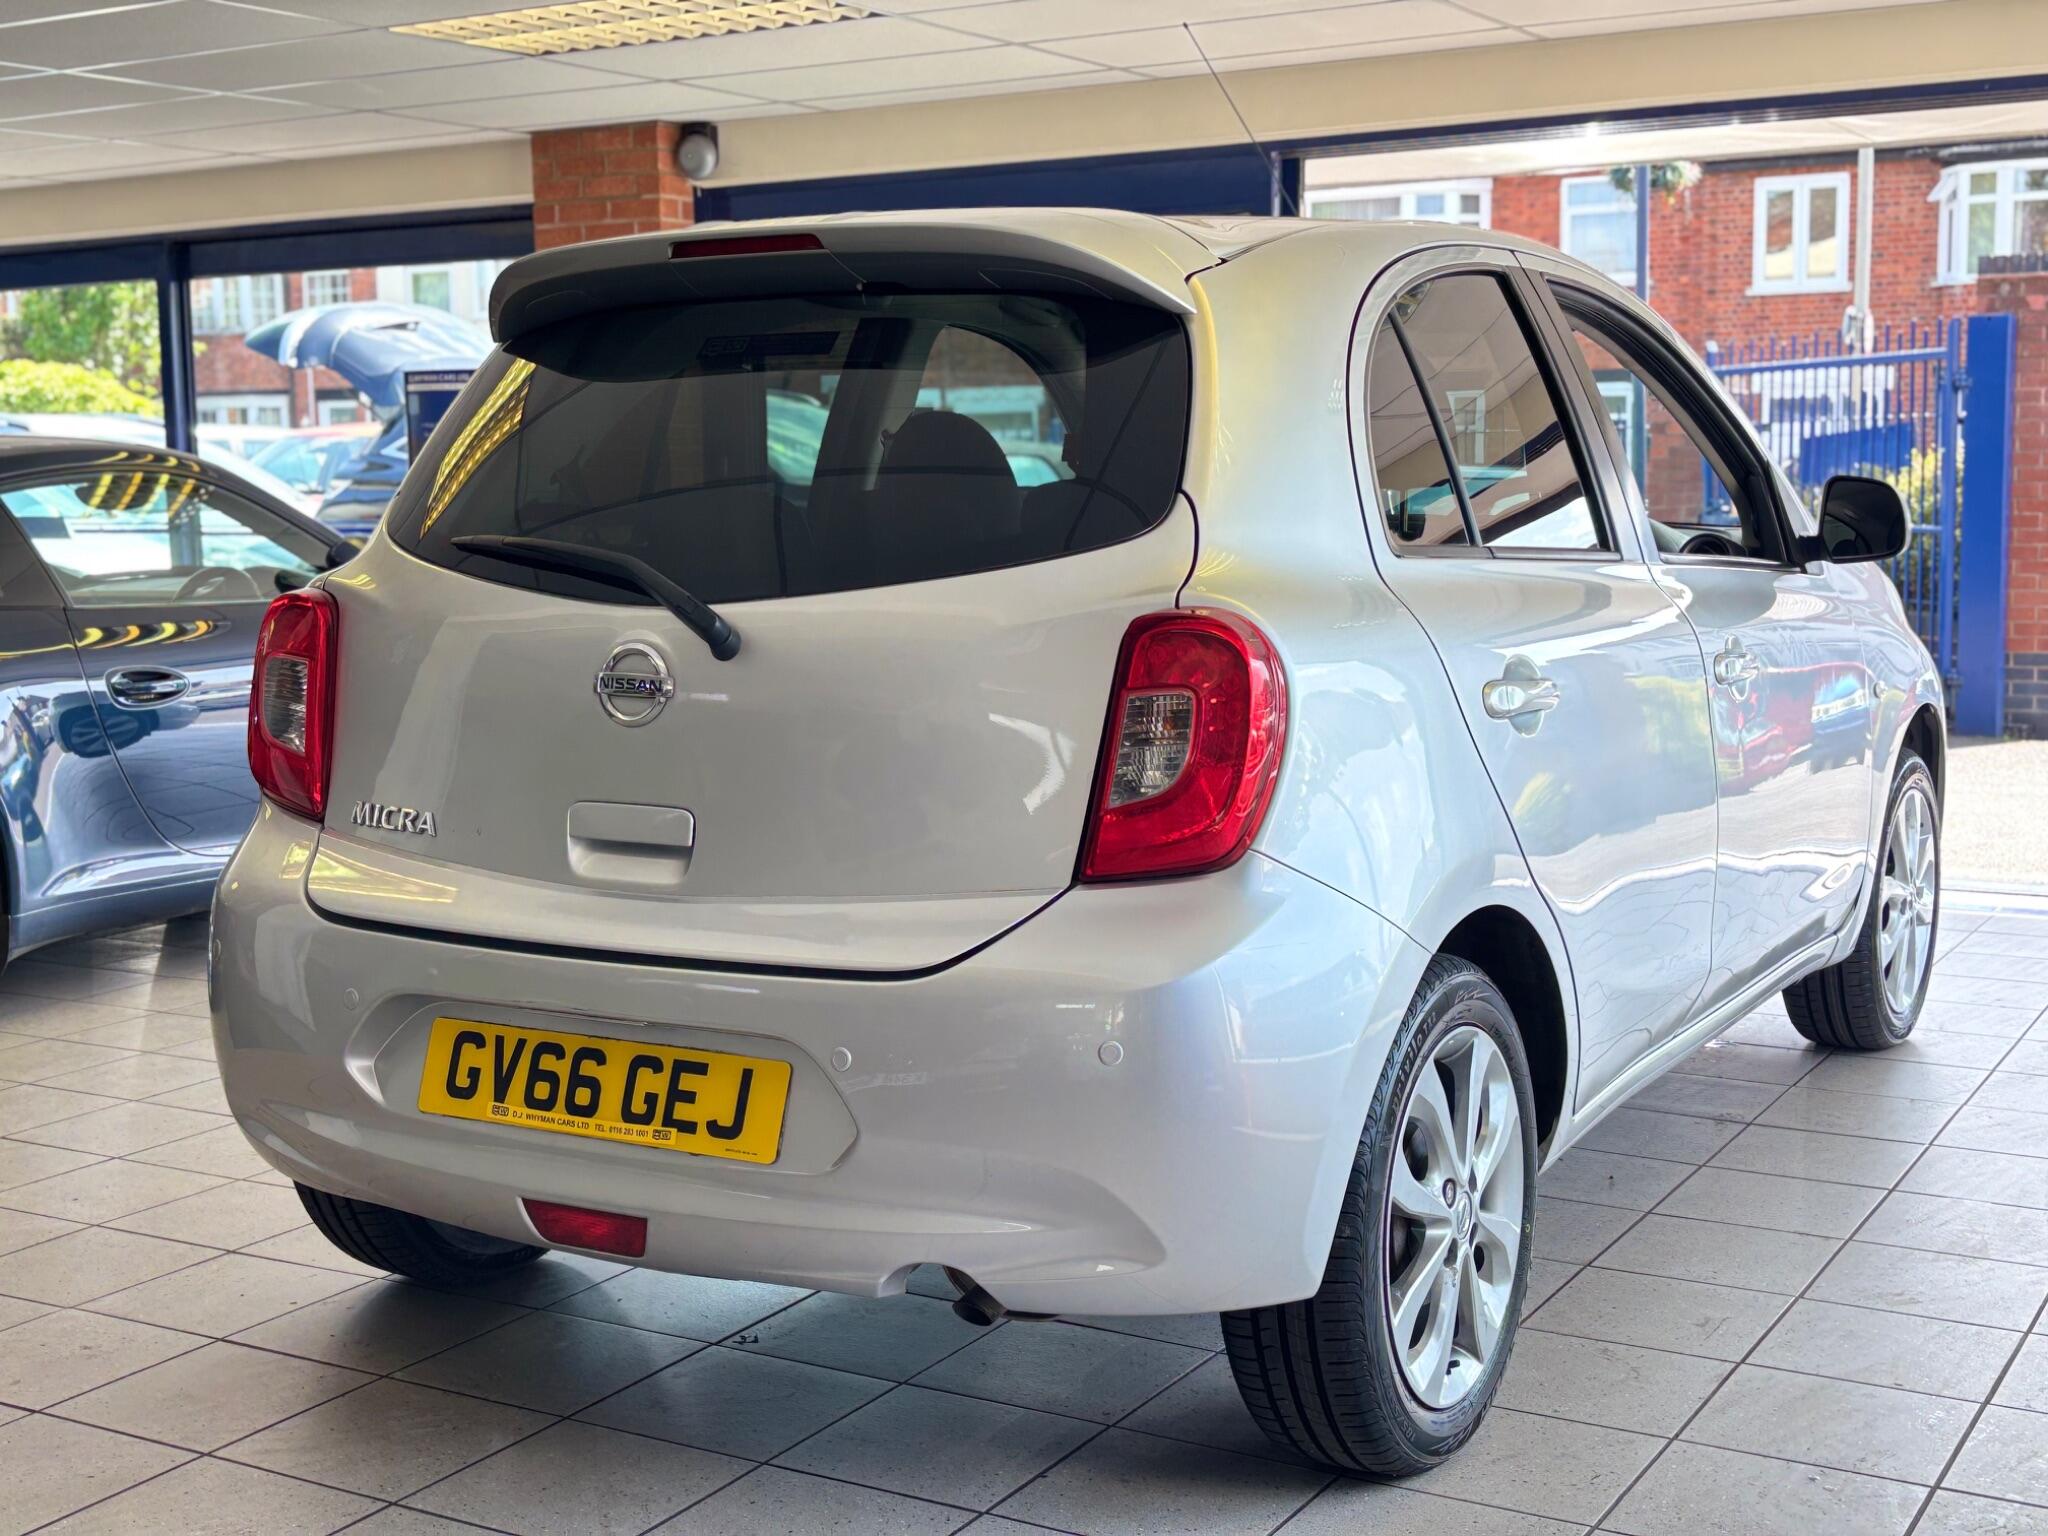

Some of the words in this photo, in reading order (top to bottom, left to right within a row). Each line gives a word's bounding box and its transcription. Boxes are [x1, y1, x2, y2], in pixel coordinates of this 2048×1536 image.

[598, 677, 663, 692] NISSAN
[350, 800, 438, 838] MICRA
[445, 1030, 607, 1118] GV66
[620, 1054, 754, 1141] GEJ
[557, 1118, 577, 1129] CARS
[577, 1120, 590, 1130] LTD
